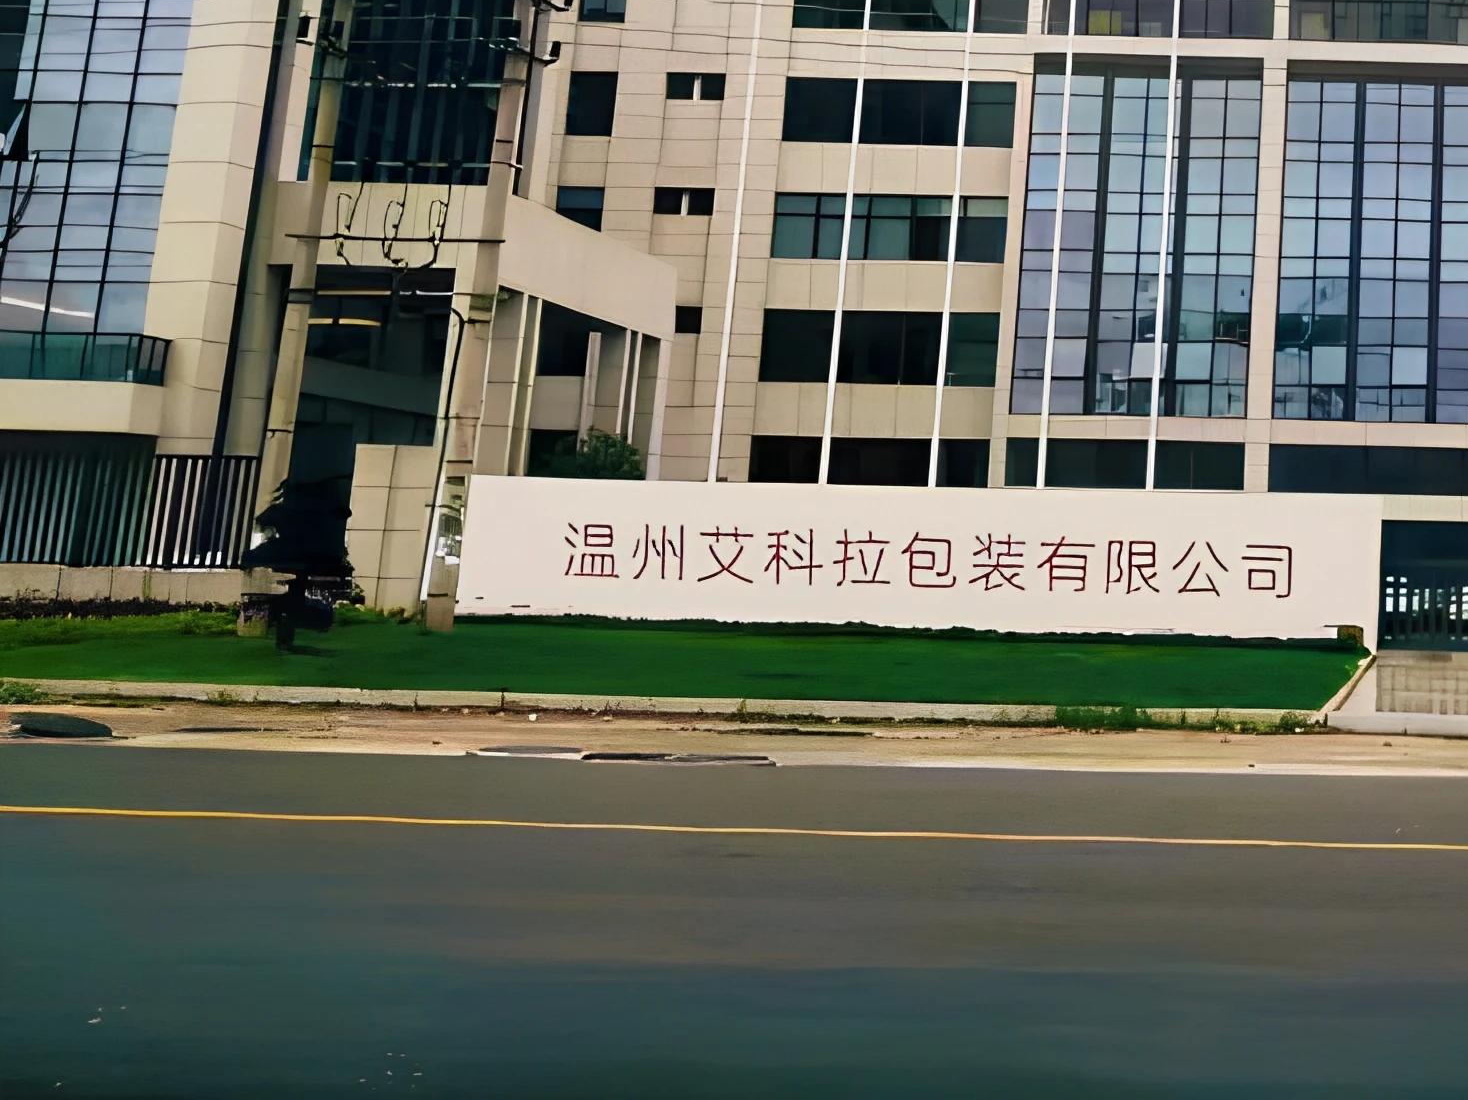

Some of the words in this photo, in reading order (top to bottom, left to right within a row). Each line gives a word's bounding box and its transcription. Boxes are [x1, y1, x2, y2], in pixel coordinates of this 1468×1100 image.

[564, 522, 1293, 599] 温州艾科拉包装有限公司
